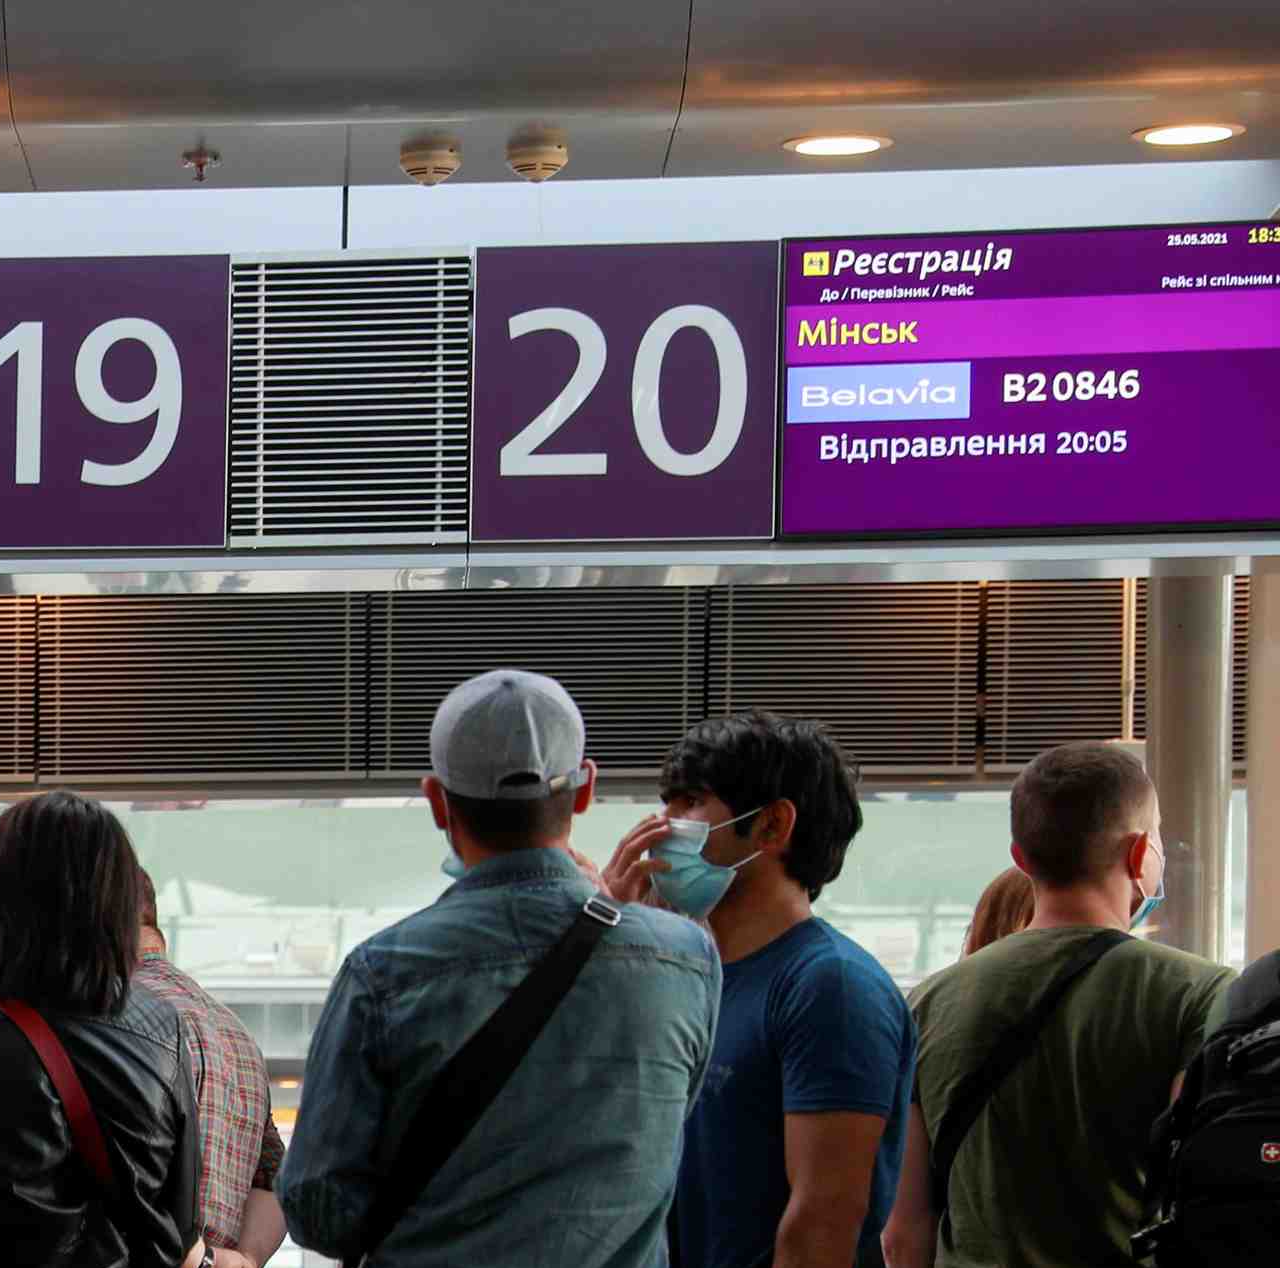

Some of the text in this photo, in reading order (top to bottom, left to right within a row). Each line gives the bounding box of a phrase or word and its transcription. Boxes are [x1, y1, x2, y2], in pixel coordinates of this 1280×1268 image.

[1168, 233, 1227, 245] 25.05.2021
[834, 243, 1012, 280] Реєстрація
[820, 289, 839, 302] До
[851, 286, 929, 301] Перевізник
[942, 284, 973, 296] Рейс
[1162, 276, 1193, 288] Рейс
[1210, 274, 1272, 286] спільним
[798, 317, 917, 346] Мінськ
[500, 305, 747, 476] 20
[801, 370, 1139, 408] Belavia B2 0846
[821, 431, 1127, 464] Відправлення 20:05
